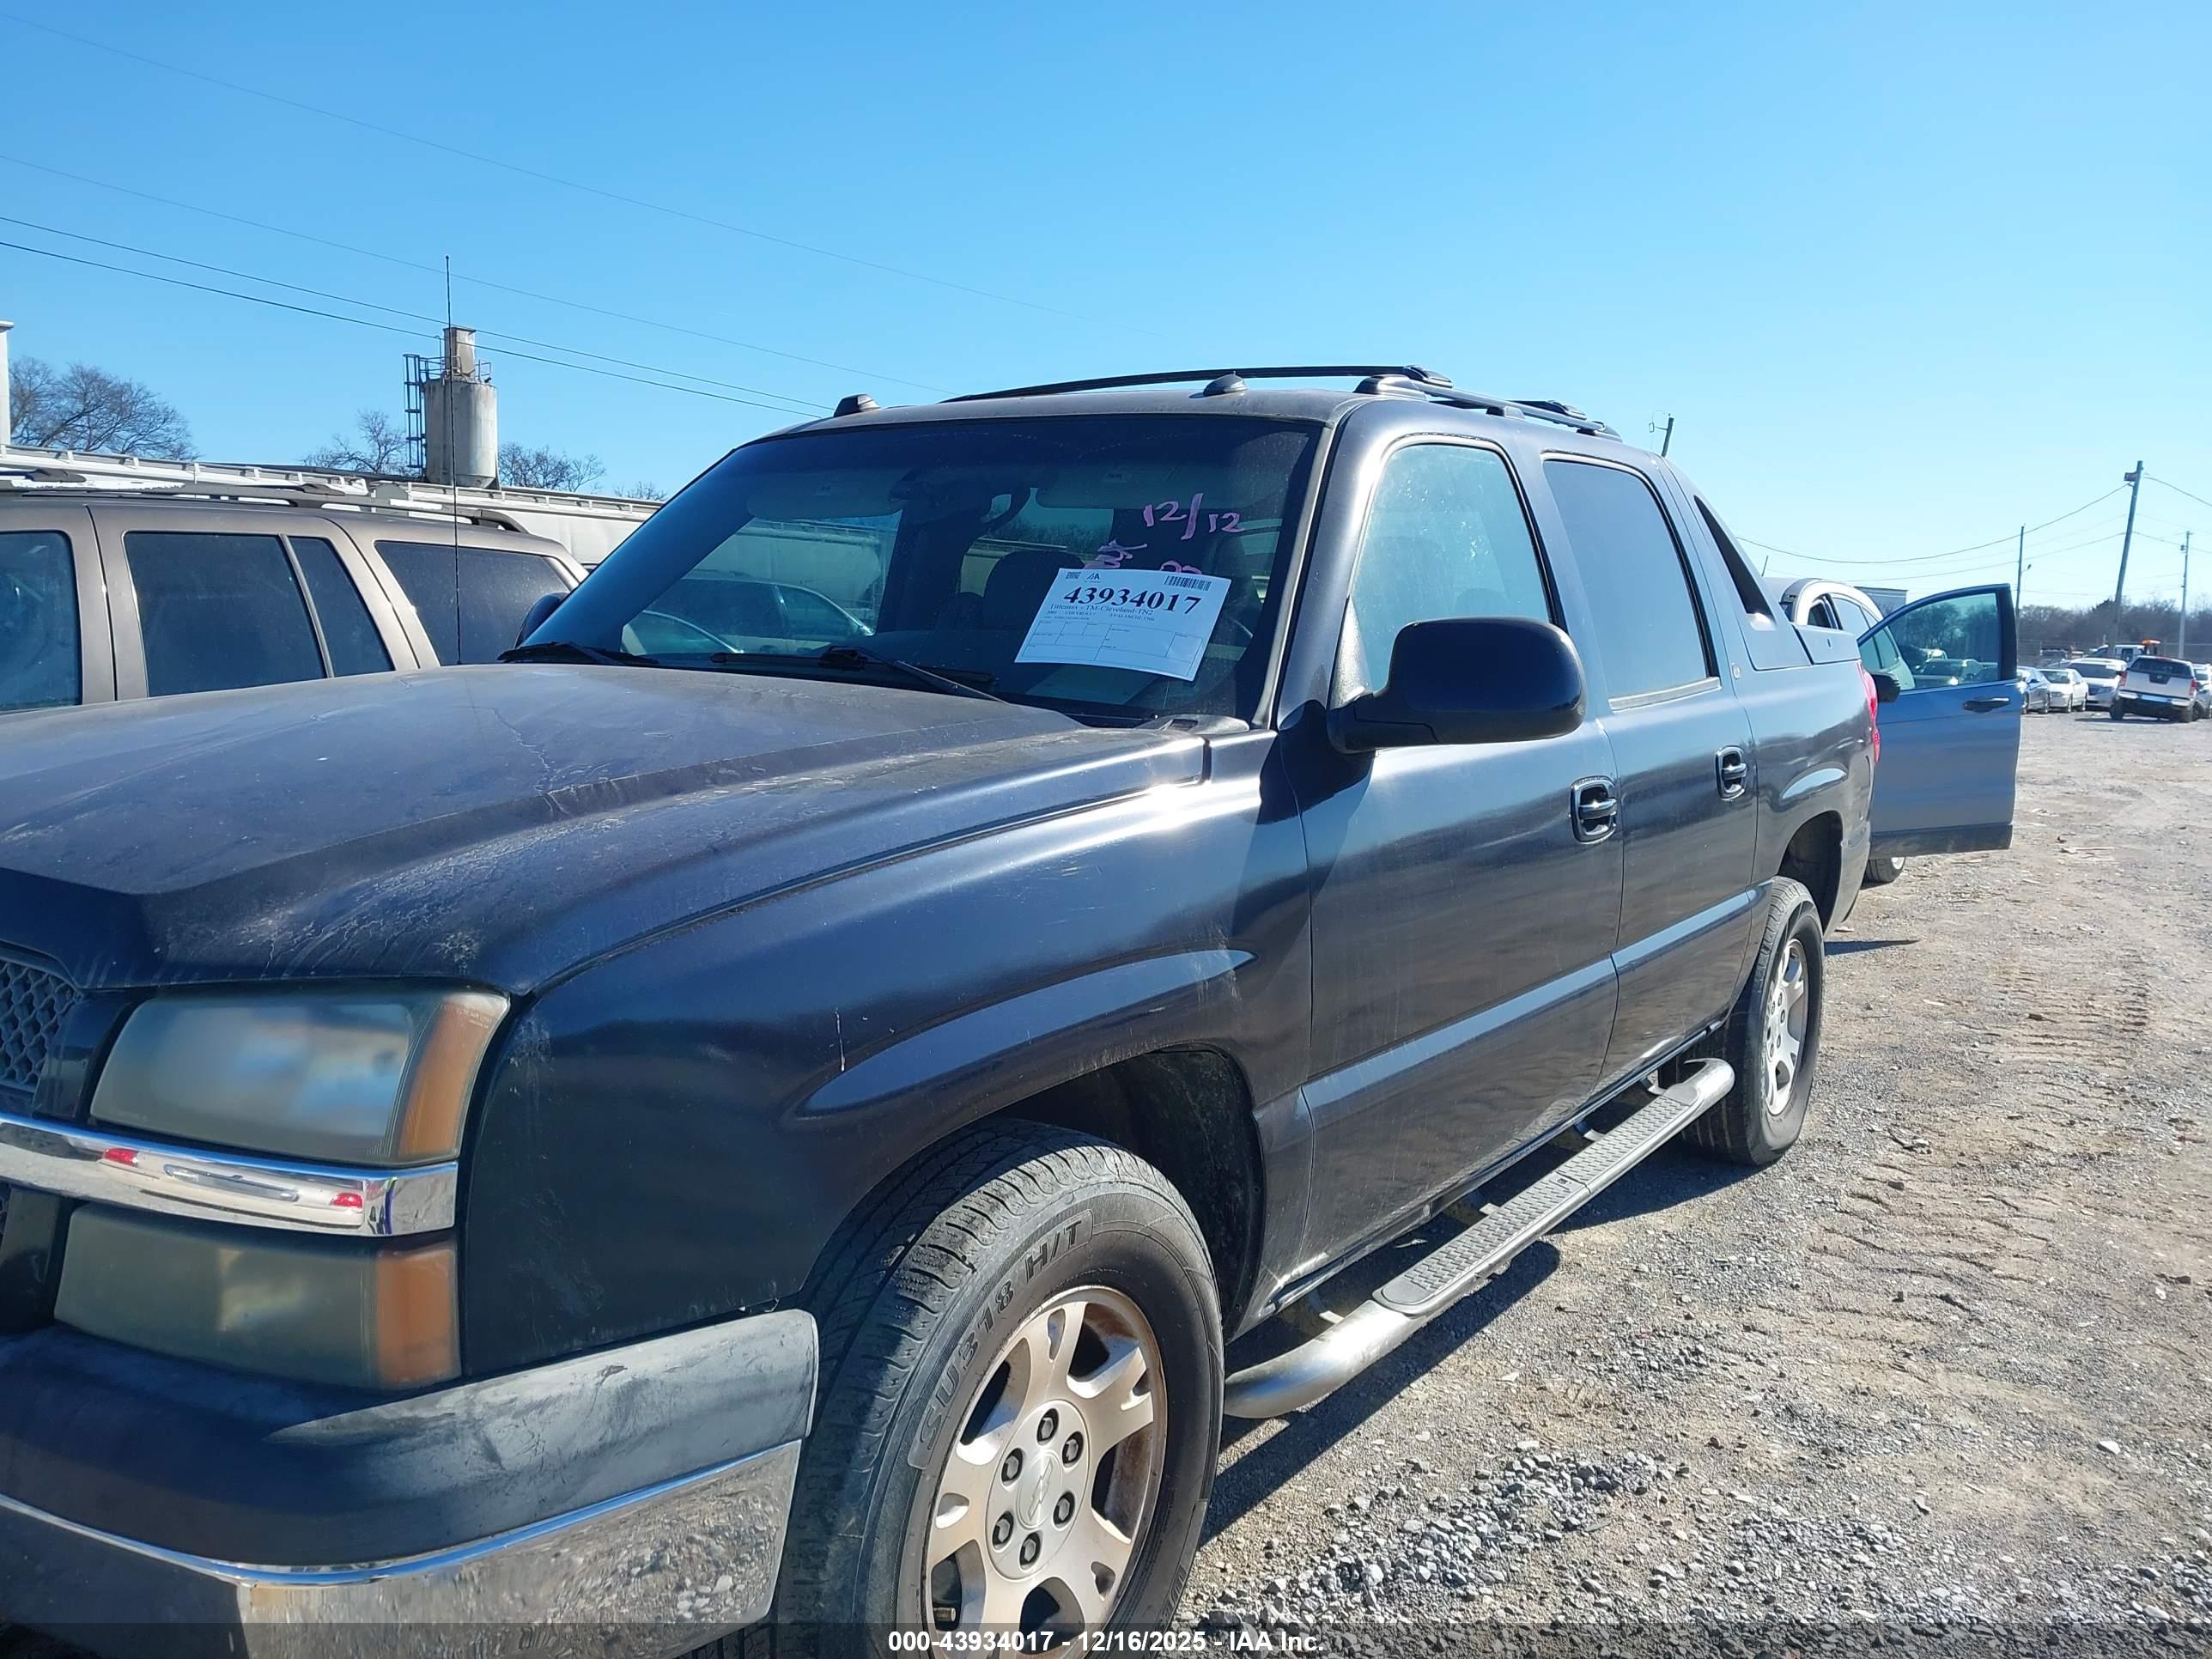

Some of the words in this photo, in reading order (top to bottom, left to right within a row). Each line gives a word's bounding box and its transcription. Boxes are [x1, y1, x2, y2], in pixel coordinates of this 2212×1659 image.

[1143, 493, 1245, 541] 12/12
[1063, 586, 1202, 615] 43934017
[1024, 1219, 1082, 1284] H/T
